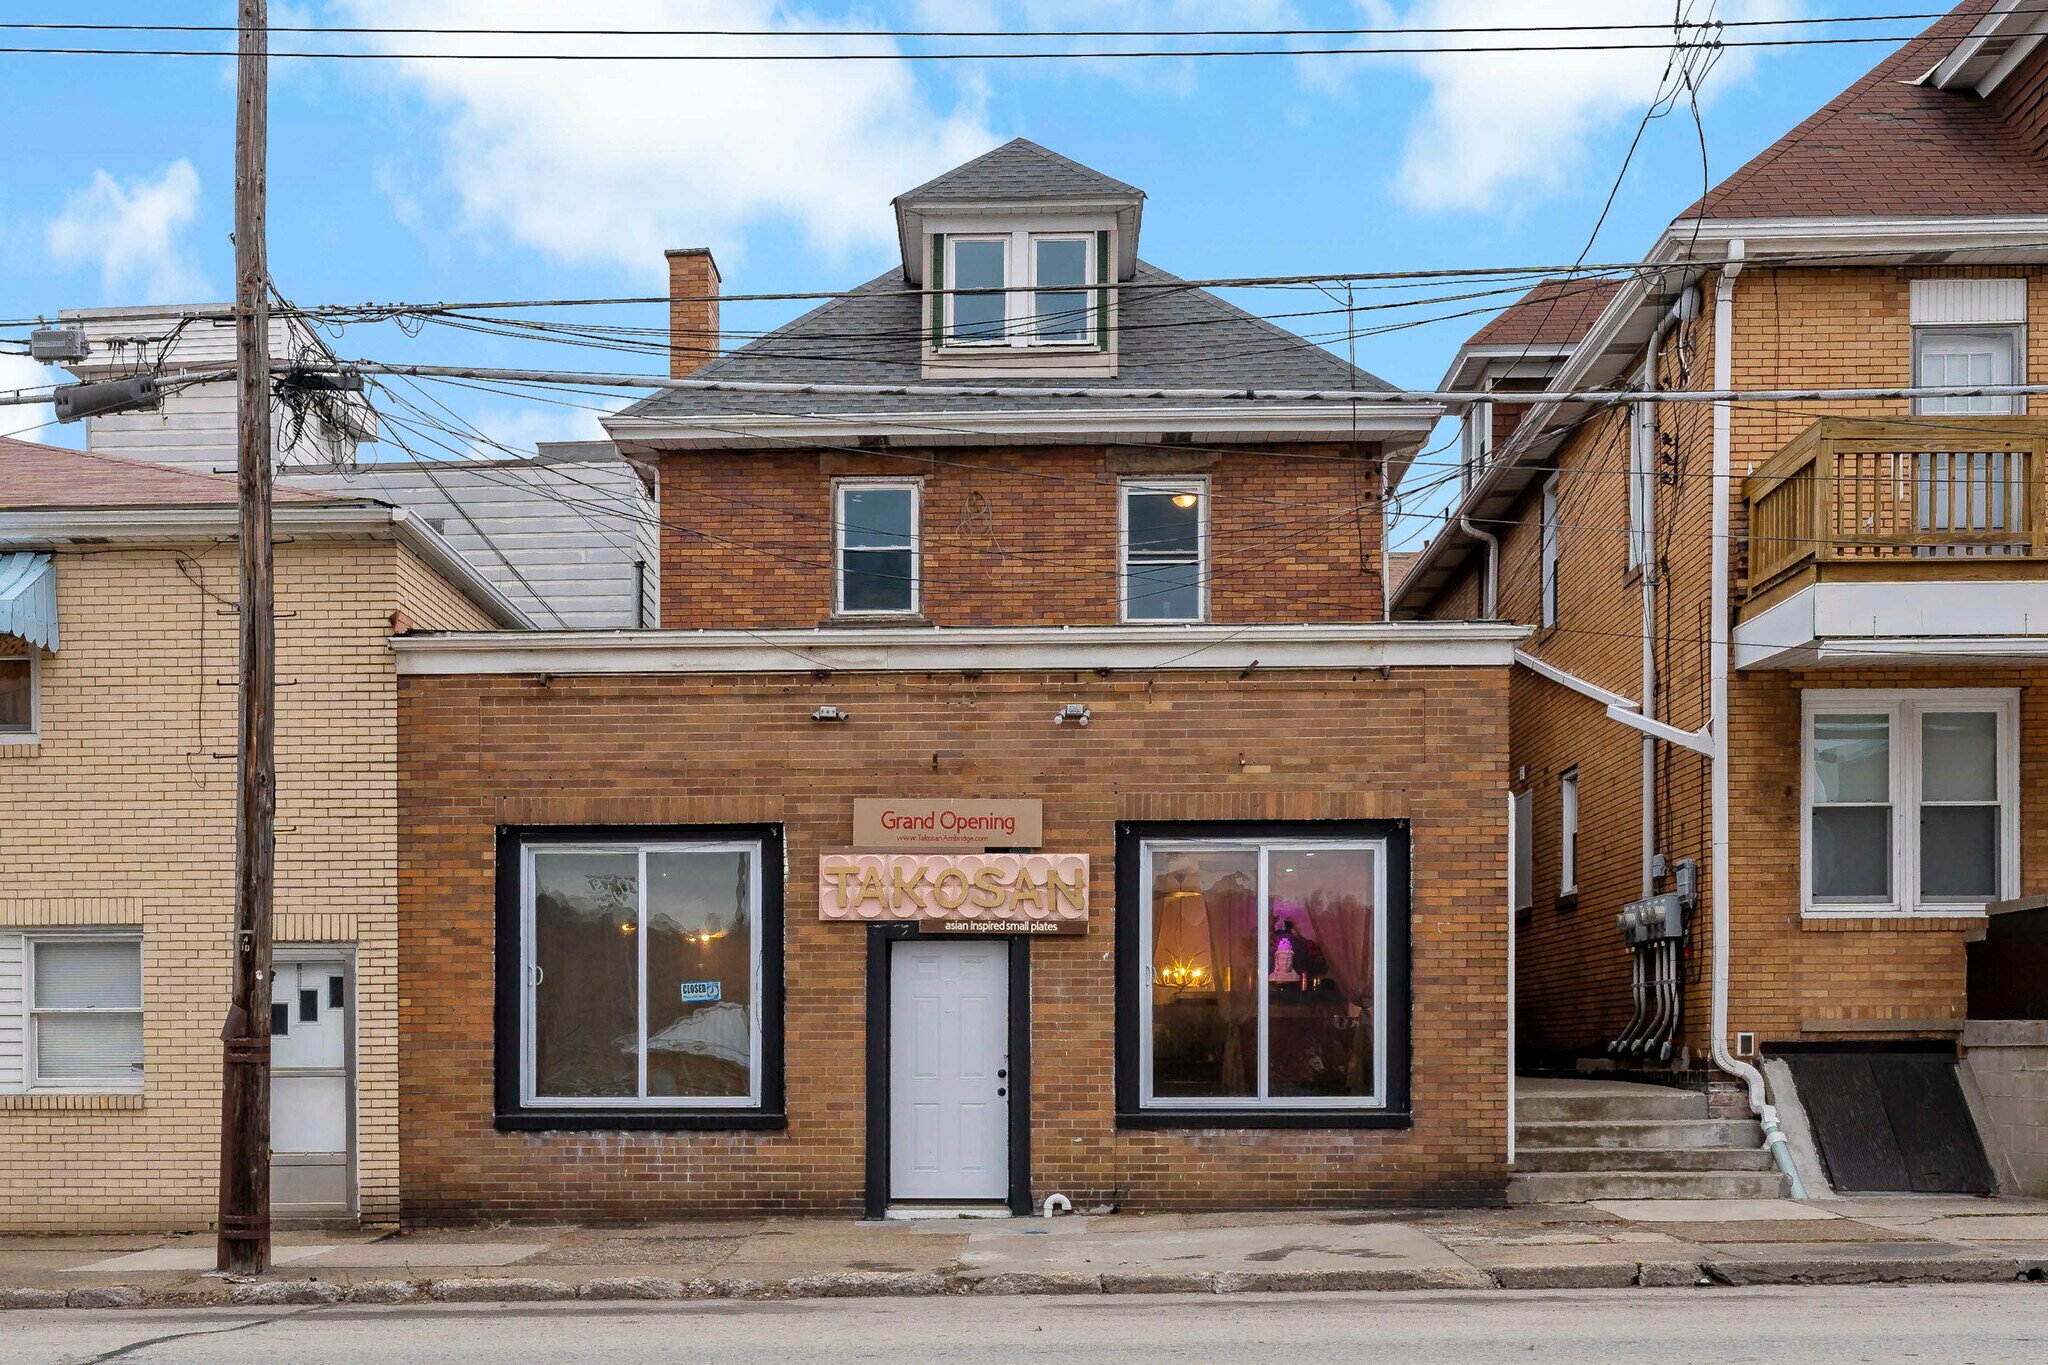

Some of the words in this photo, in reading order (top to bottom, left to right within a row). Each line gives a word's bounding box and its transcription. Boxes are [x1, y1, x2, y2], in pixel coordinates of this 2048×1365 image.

[881, 810, 934, 829] Grand
[940, 810, 1015, 835] Opening
[824, 866, 1084, 911] TAKOSAN
[945, 921, 968, 930] asian
[970, 921, 1005, 932] inspired
[1006, 921, 1029, 931] small
[1030, 921, 1058, 932] plates
[682, 984, 706, 994] CLOSED
